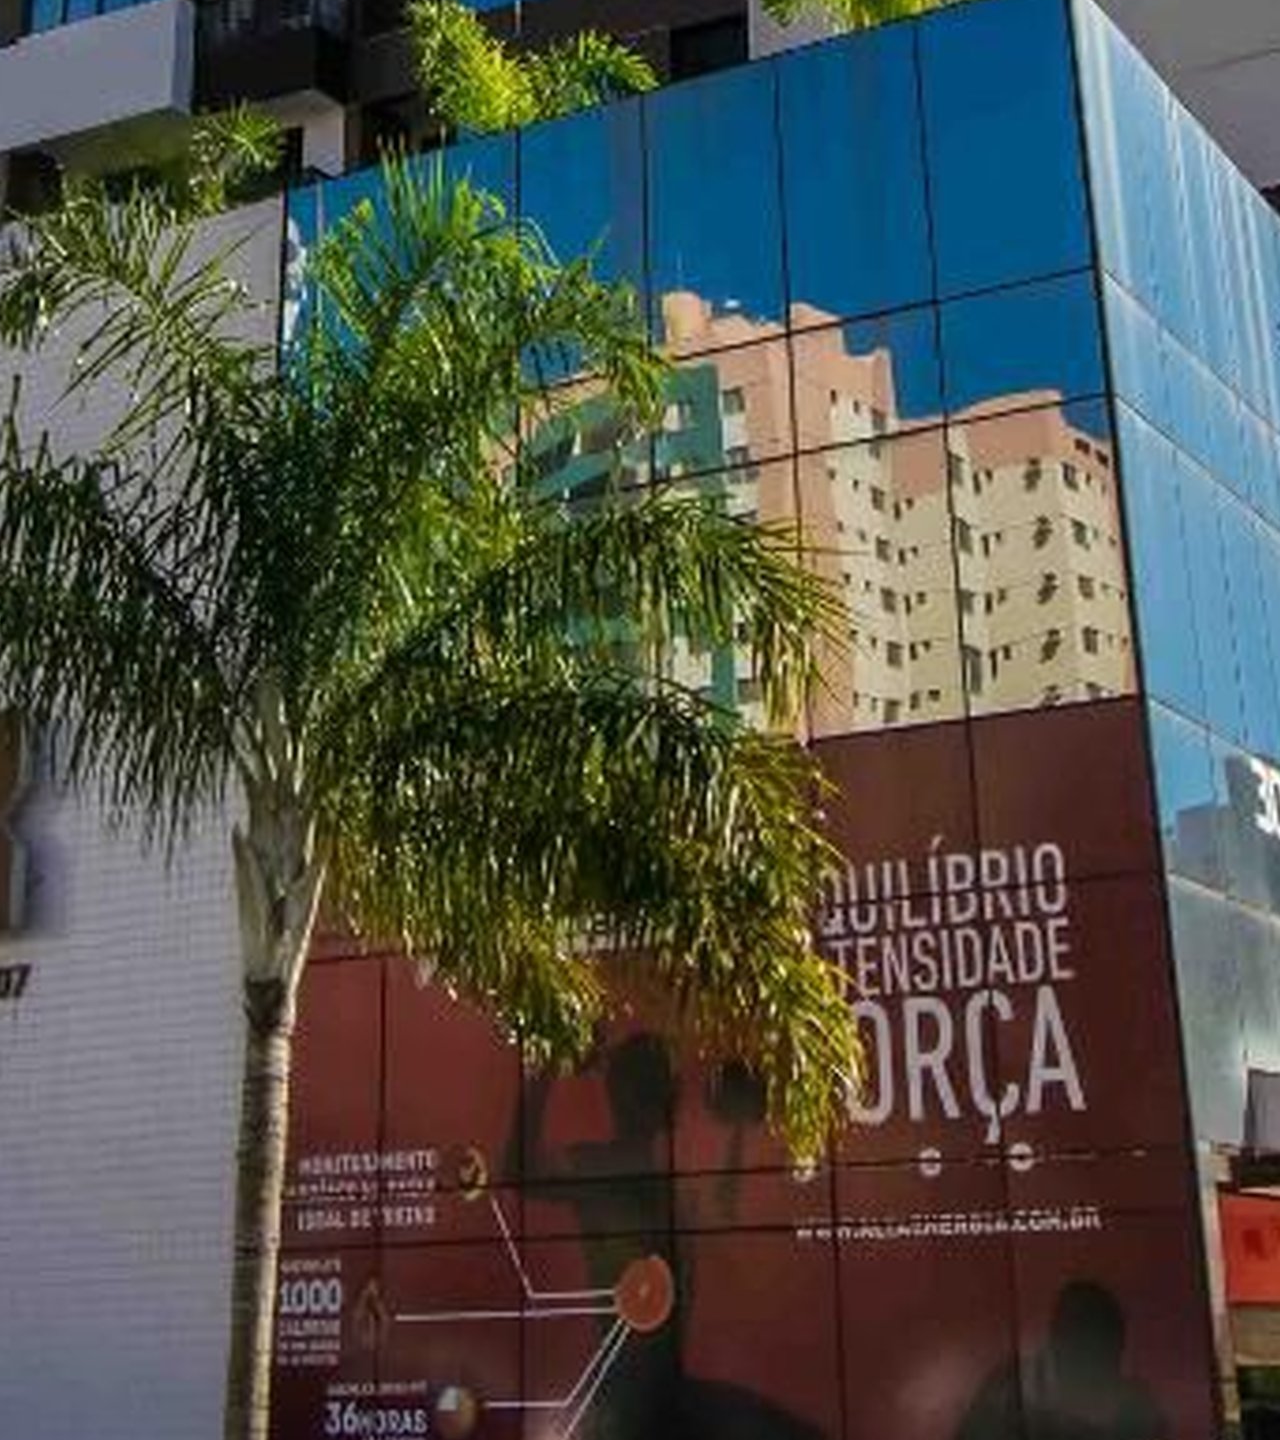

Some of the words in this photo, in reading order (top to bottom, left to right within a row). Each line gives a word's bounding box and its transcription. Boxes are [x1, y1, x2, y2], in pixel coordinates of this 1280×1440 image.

[820, 835, 1067, 935] QUILÍBRIO
[832, 918, 1075, 997] TENSIDADE
[845, 984, 1087, 1145] ORÇA
[280, 1278, 342, 1314] 1000
